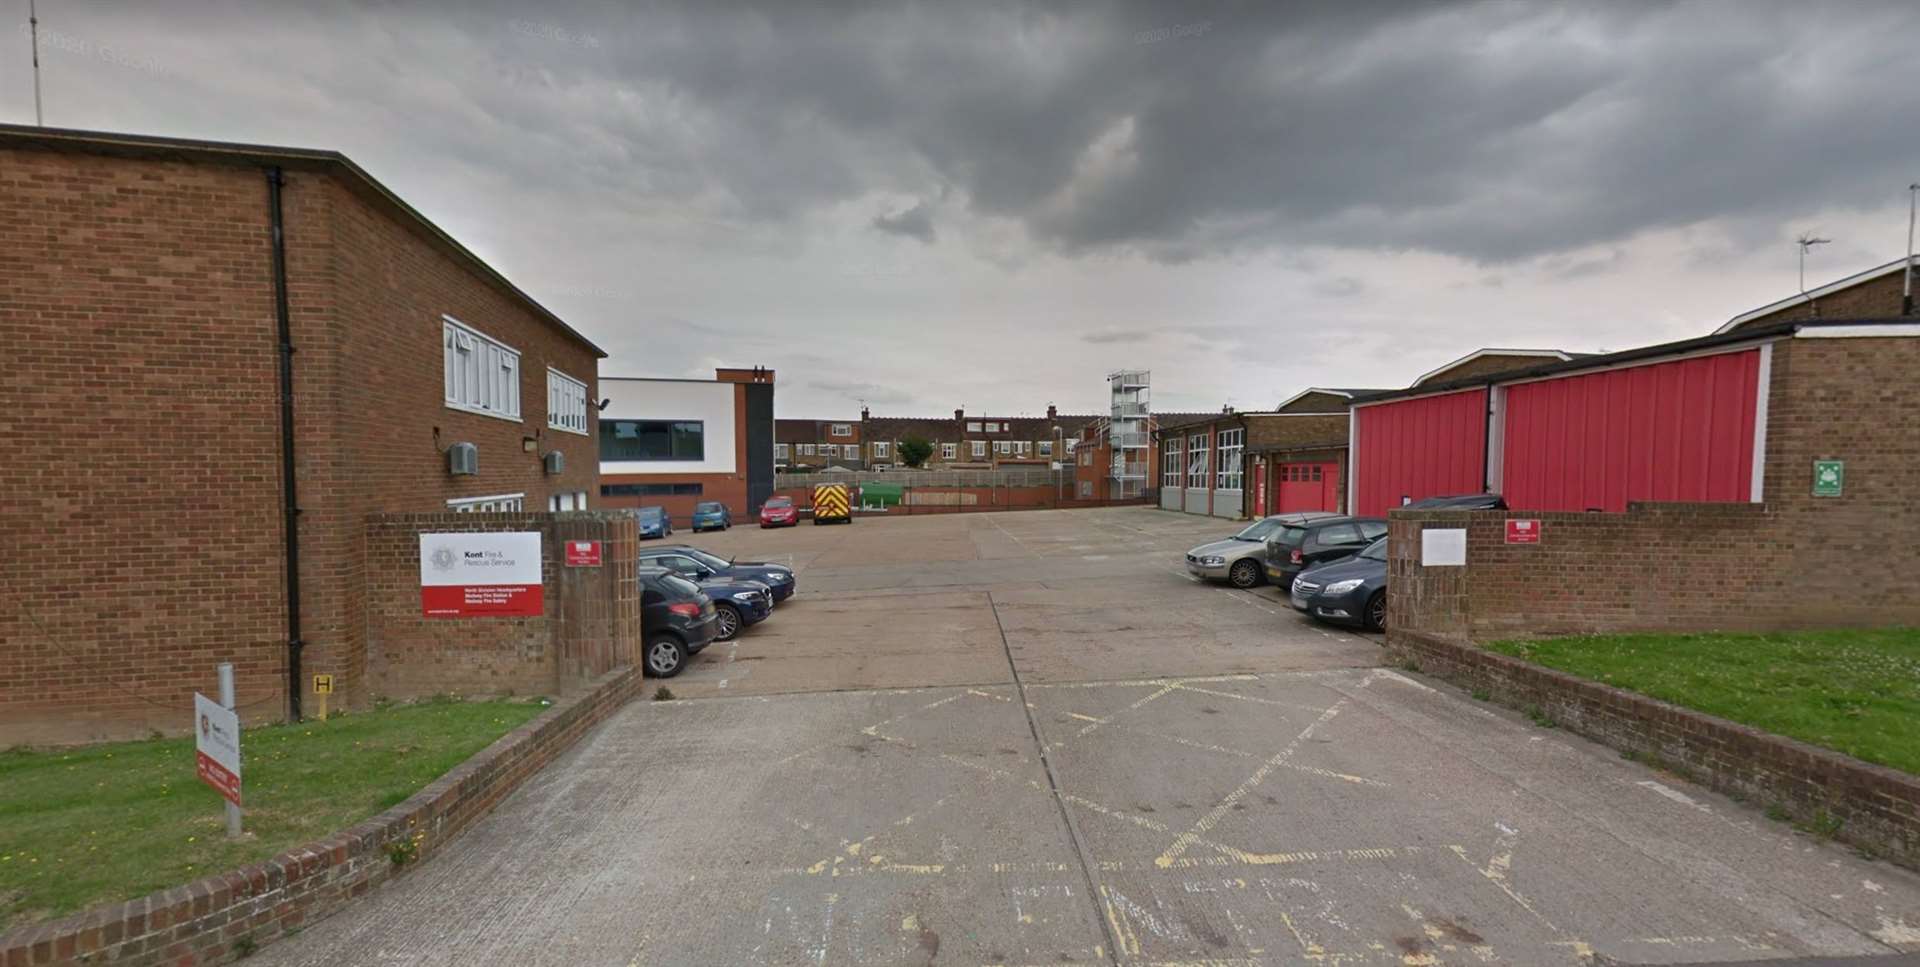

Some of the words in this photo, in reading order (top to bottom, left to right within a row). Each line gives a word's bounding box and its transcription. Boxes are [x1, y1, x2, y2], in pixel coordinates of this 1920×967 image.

[464, 551, 483, 559] Kent
[491, 559, 516, 567] Service
[316, 677, 330, 692] H
